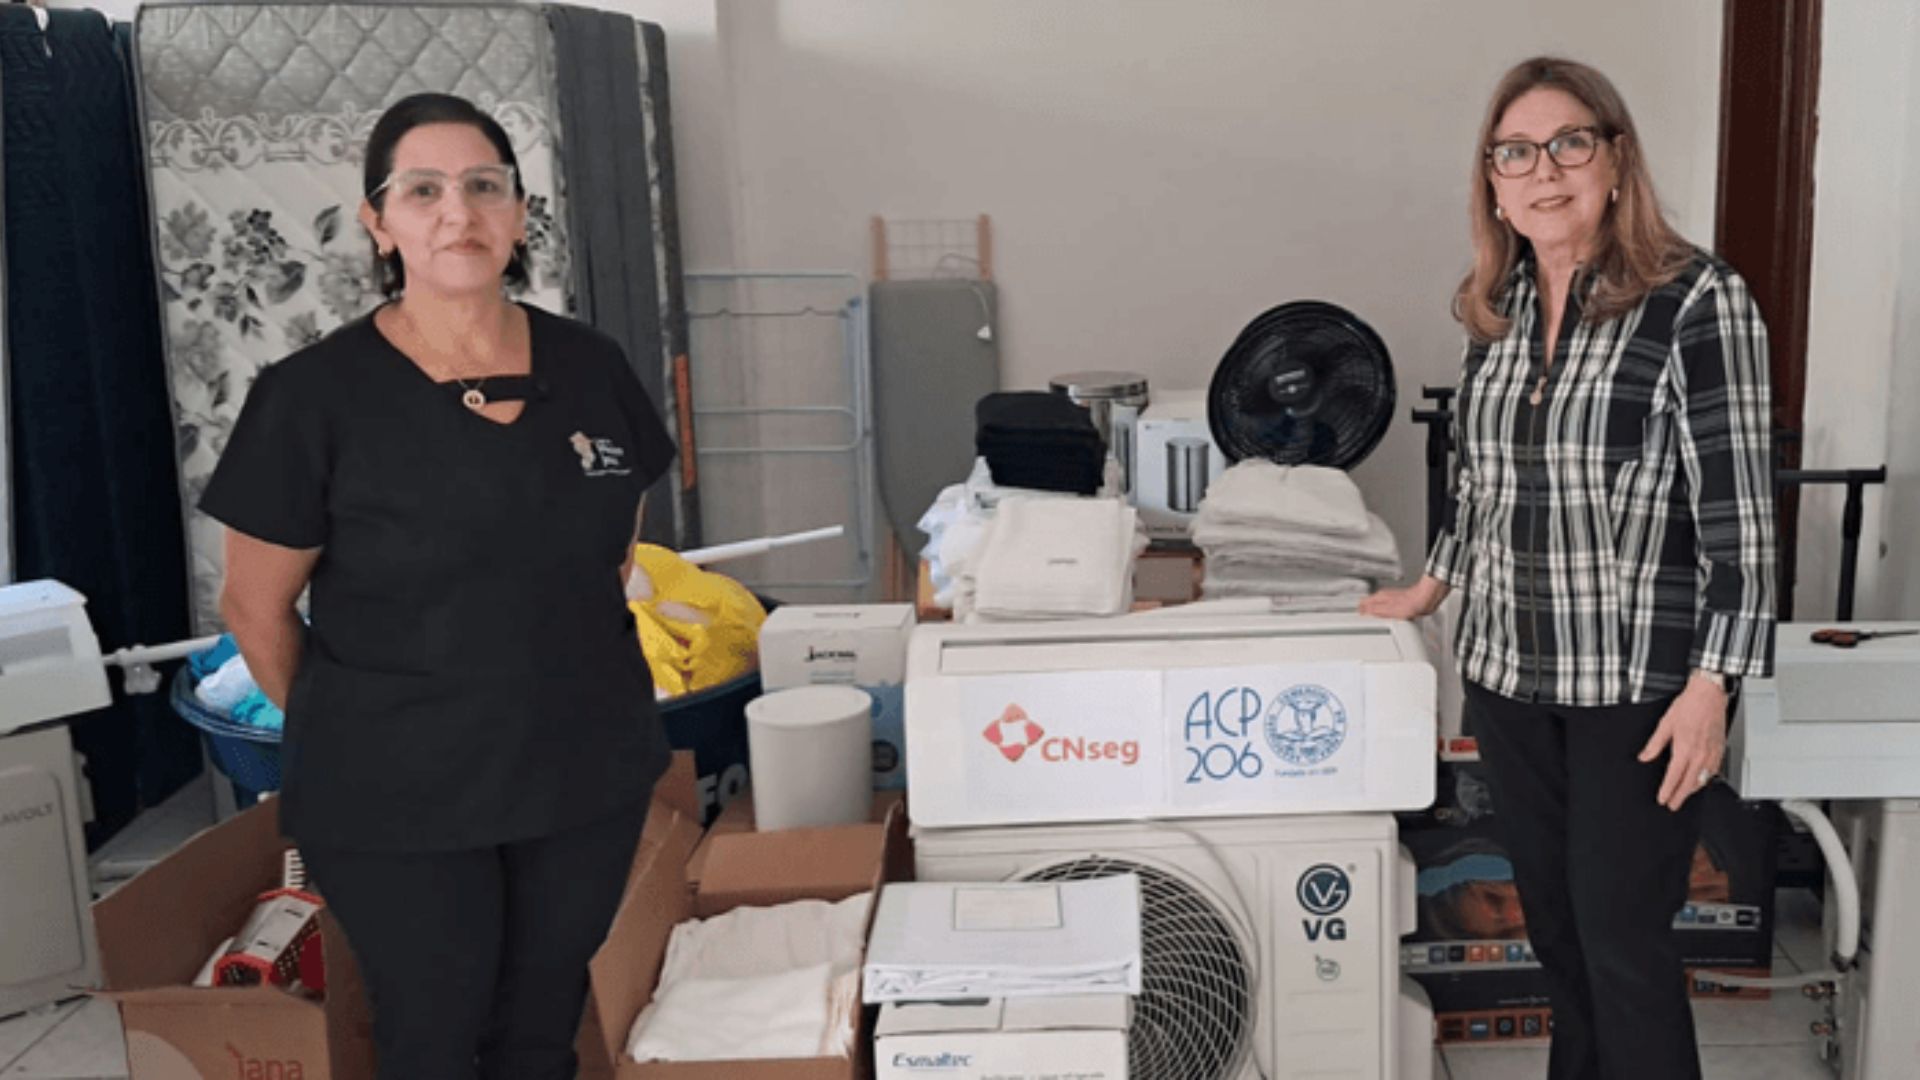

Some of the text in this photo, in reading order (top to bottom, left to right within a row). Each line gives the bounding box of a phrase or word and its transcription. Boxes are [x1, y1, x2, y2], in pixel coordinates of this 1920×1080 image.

[1184, 686, 1262, 742] ACP
[1040, 737, 1140, 765] CNseg
[1184, 741, 1263, 784] 206
[1301, 918, 1348, 942] VG
